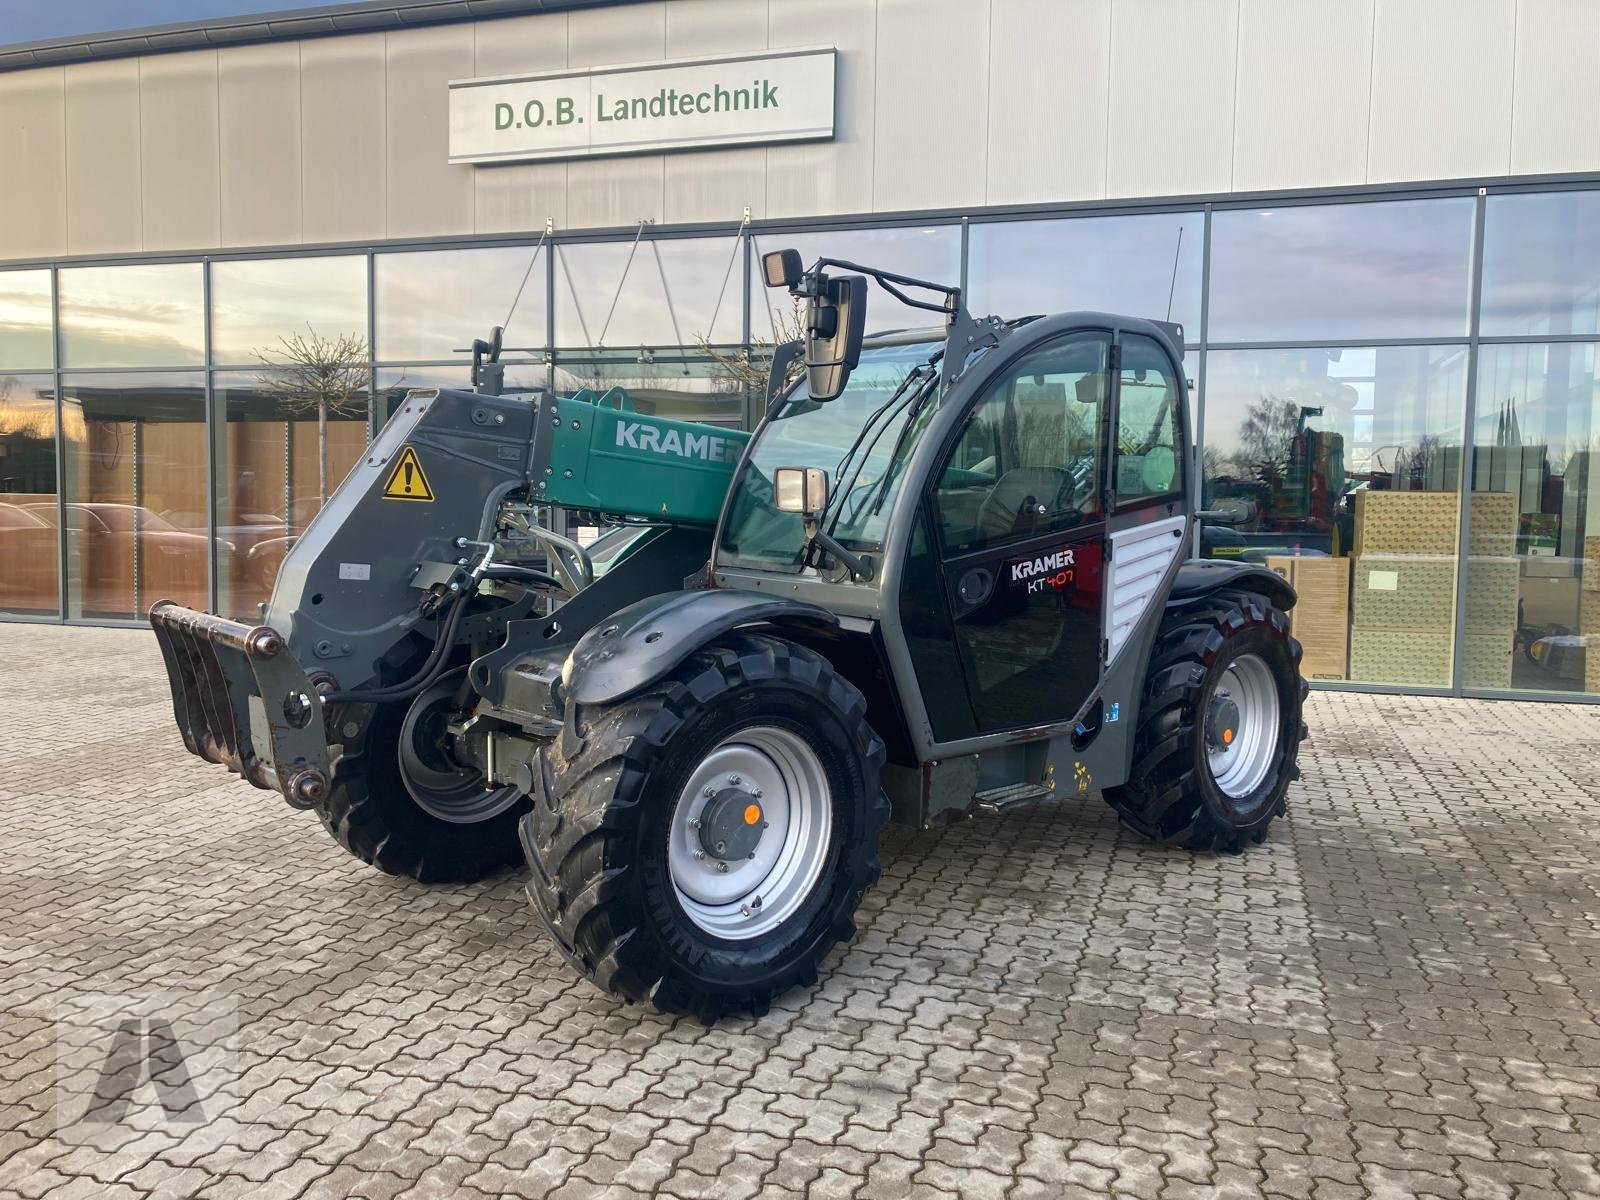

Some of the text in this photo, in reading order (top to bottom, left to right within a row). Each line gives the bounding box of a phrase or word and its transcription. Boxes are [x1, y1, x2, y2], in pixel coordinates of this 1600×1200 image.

[494, 80, 779, 130] D.O.B. Landtechnik
[615, 420, 745, 464] KRAMER
[1011, 549, 1075, 580] KRAMER
